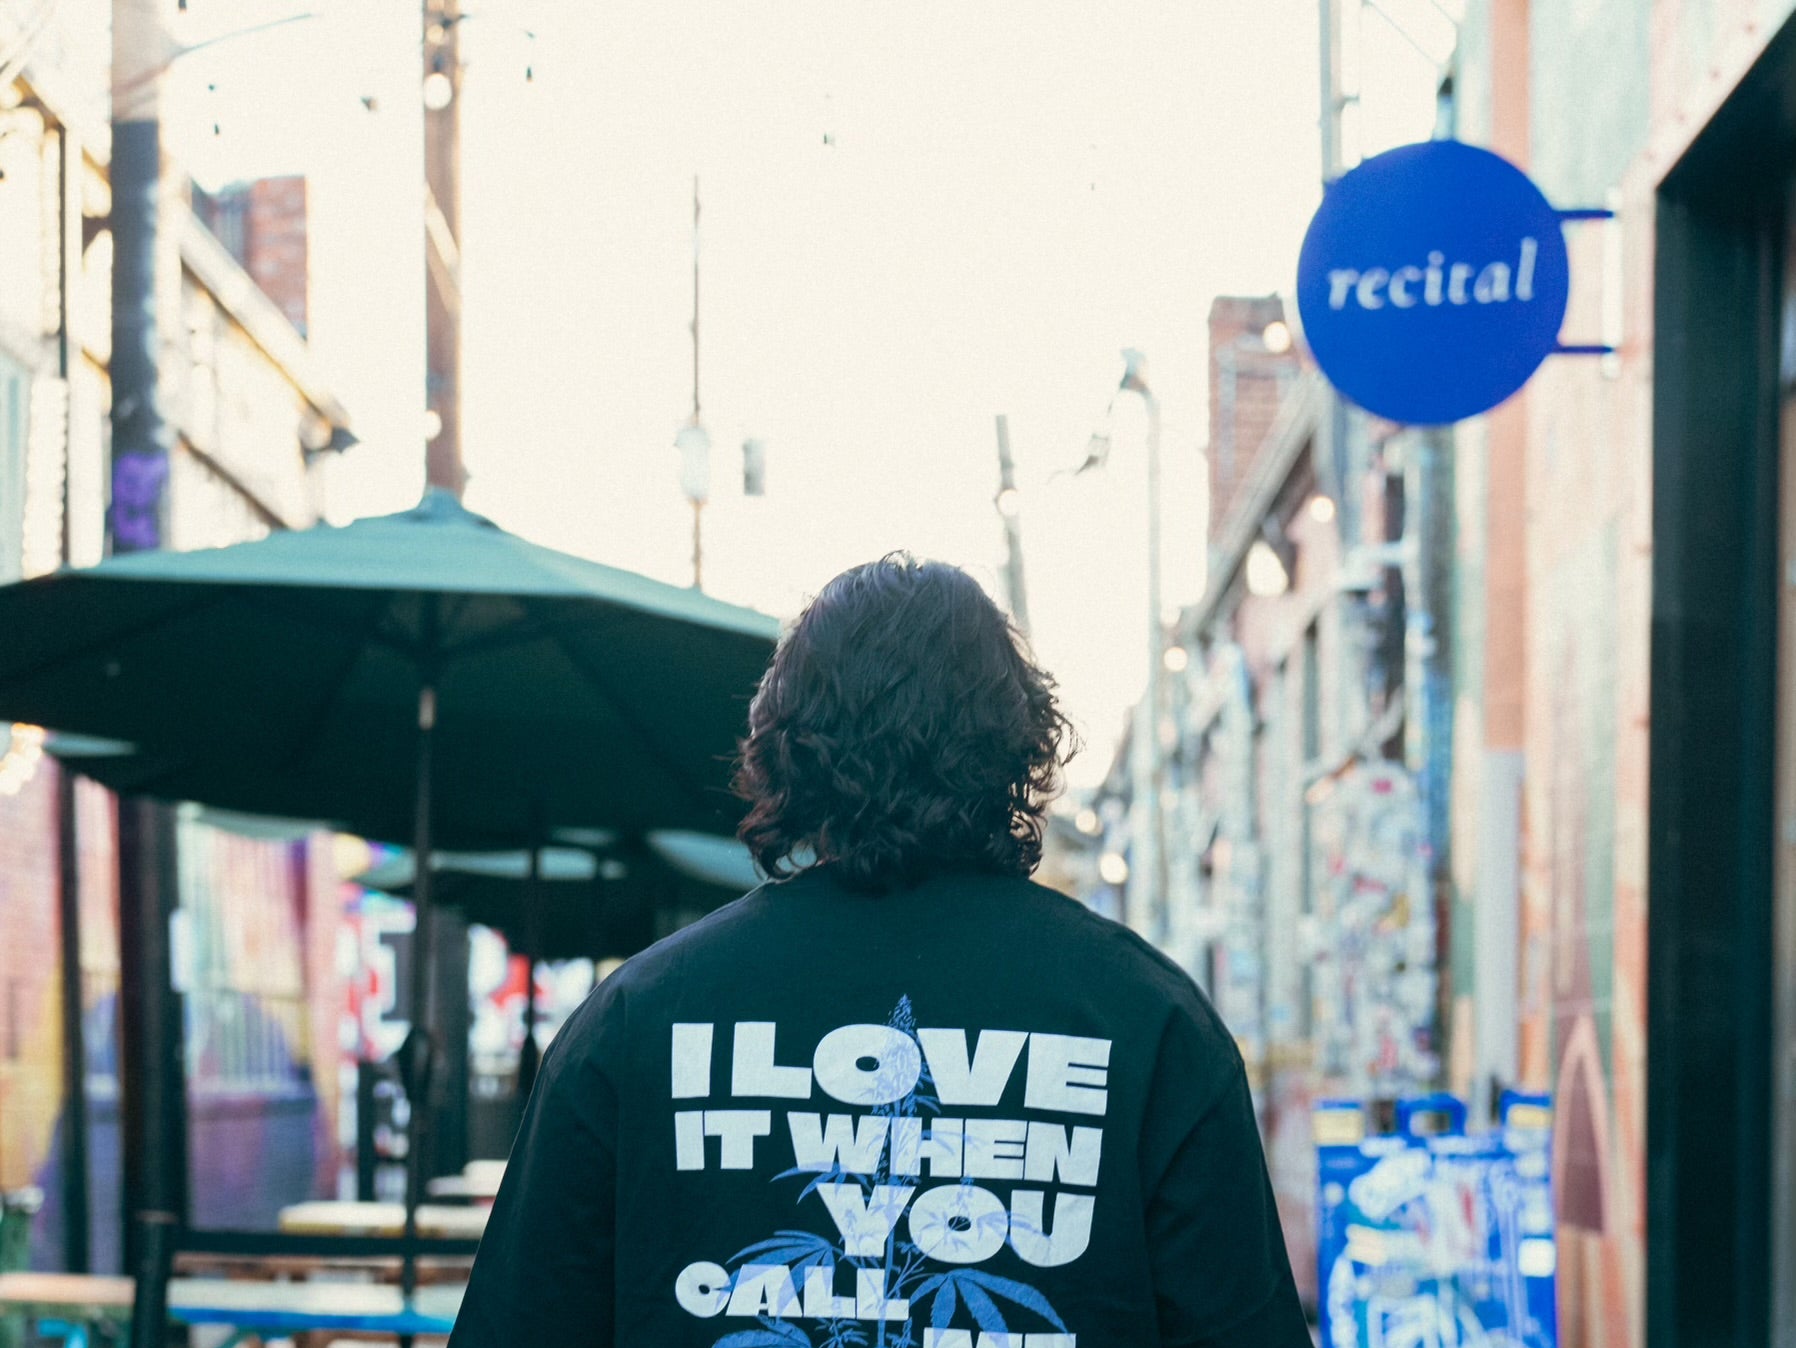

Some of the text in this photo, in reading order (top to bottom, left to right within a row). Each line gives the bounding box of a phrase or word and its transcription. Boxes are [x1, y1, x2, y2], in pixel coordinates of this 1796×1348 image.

[1327, 236, 1538, 311] recital
[671, 1021, 1113, 1117] I LOVE
[674, 1109, 1104, 1188] IT WHEN
[815, 1182, 1097, 1268] YOU
[674, 1260, 910, 1321] CALL
